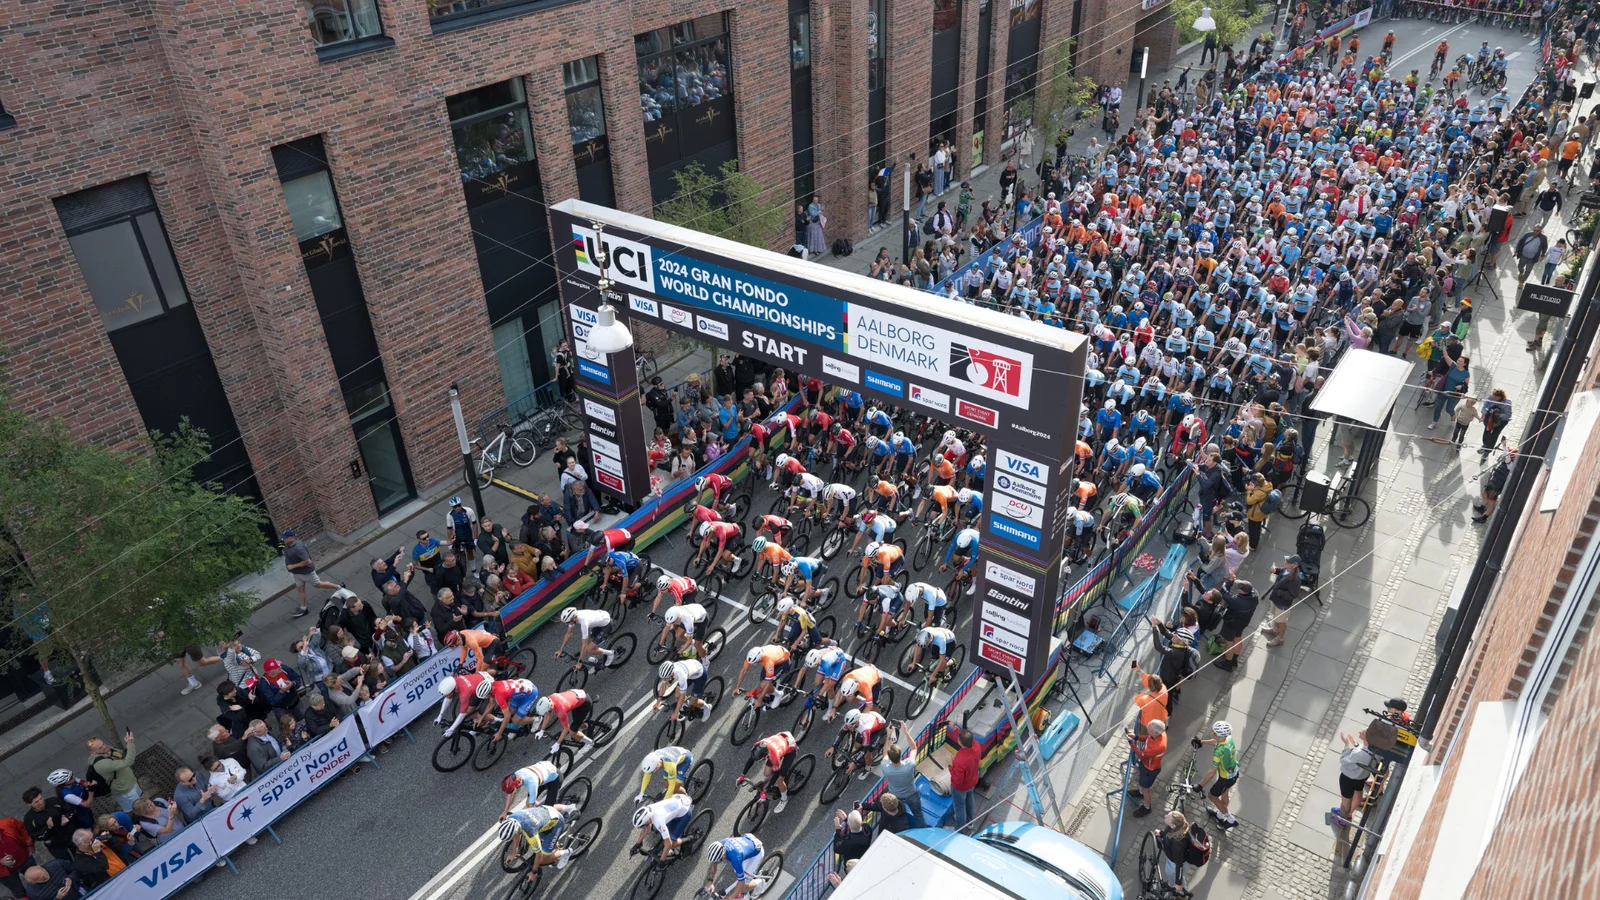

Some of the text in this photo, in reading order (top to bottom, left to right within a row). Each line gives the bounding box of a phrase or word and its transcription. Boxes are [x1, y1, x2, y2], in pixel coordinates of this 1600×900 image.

[585, 236, 648, 283] UCI
[658, 258, 789, 307] 2024 GRAN FONDO
[576, 309, 597, 323] VISA
[634, 298, 654, 312] VISA
[660, 275, 836, 340] WORLD CHAMPIONSHIPS
[857, 316, 935, 350] AALBORG
[741, 330, 807, 365] START
[857, 335, 938, 372] DENMARK
[581, 364, 608, 379] SHIMANO
[867, 375, 901, 391] SHIMANO
[590, 422, 615, 438] Santini
[1011, 423, 1051, 440] #Aalborg2024
[1005, 456, 1040, 478] VISA
[1011, 487, 1042, 500] Kommune
[1012, 481, 1036, 495] Aalborg
[1009, 500, 1028, 511] DCU
[993, 521, 1037, 542] SHIMANO
[1000, 572, 1033, 590] spar Nord
[987, 588, 1030, 611] Santini
[985, 608, 1006, 622] salling
[995, 636, 1024, 652] spar Nord
[402, 662, 438, 690] Powered
[439, 656, 448, 666] by
[406, 671, 439, 704] spar
[258, 751, 312, 793] Powered by
[261, 737, 348, 806] spar Nord
[310, 751, 350, 783] FONDEN
[135, 843, 203, 889] VISA
